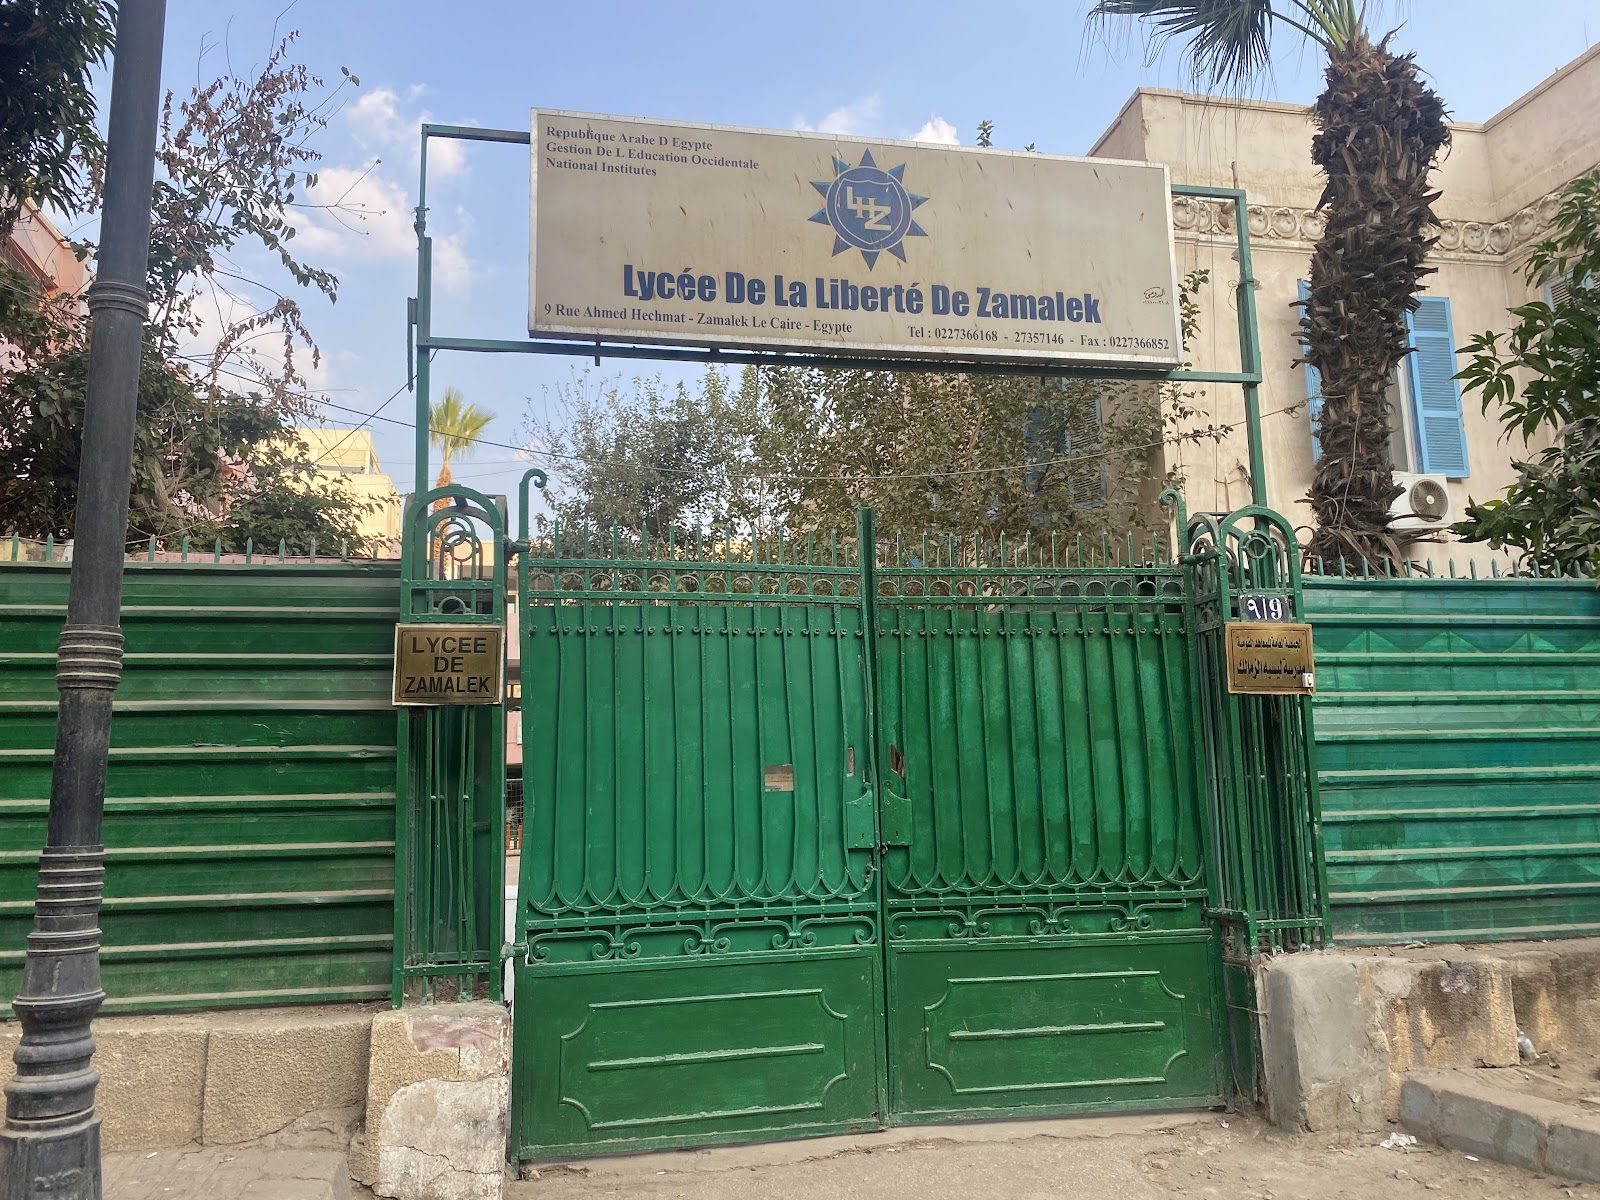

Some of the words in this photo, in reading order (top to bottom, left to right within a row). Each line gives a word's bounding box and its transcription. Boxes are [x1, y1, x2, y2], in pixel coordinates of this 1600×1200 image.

[546, 126, 616, 143] Republique
[619, 133, 656, 147] Arabe
[659, 136, 669, 147] D
[672, 138, 713, 152] Egypte
[546, 142, 593, 156] Gestion
[597, 146, 613, 158] De
[616, 148, 626, 159] L
[628, 149, 688, 164] Education
[692, 154, 760, 170] Occidentale
[546, 158, 599, 172] National
[602, 162, 657, 177] Institutes
[623, 265, 717, 302] Lycée
[725, 272, 766, 306] De
[774, 275, 808, 308] La
[815, 277, 924, 315] Liberté
[931, 285, 970, 318] De
[976, 287, 1102, 324] Zamalek
[544, 303, 552, 316] 9
[556, 304, 580, 318] Rue
[584, 306, 627, 321] Ahmed
[631, 309, 686, 324] Hechmat
[698, 313, 749, 328] Zamalek
[752, 316, 767, 329] Le
[771, 317, 802, 331] Caire
[813, 320, 853, 336] Egypte
[908, 326, 925, 339] Tel
[934, 328, 998, 342] 0227366168
[1014, 332, 1065, 345] 27357146
[1080, 335, 1100, 347] Fax
[1109, 336, 1169, 350] 0227366852
[412, 636, 487, 653] LYCEE
[434, 656, 464, 673] DE
[404, 676, 491, 693] ZAMALEK
